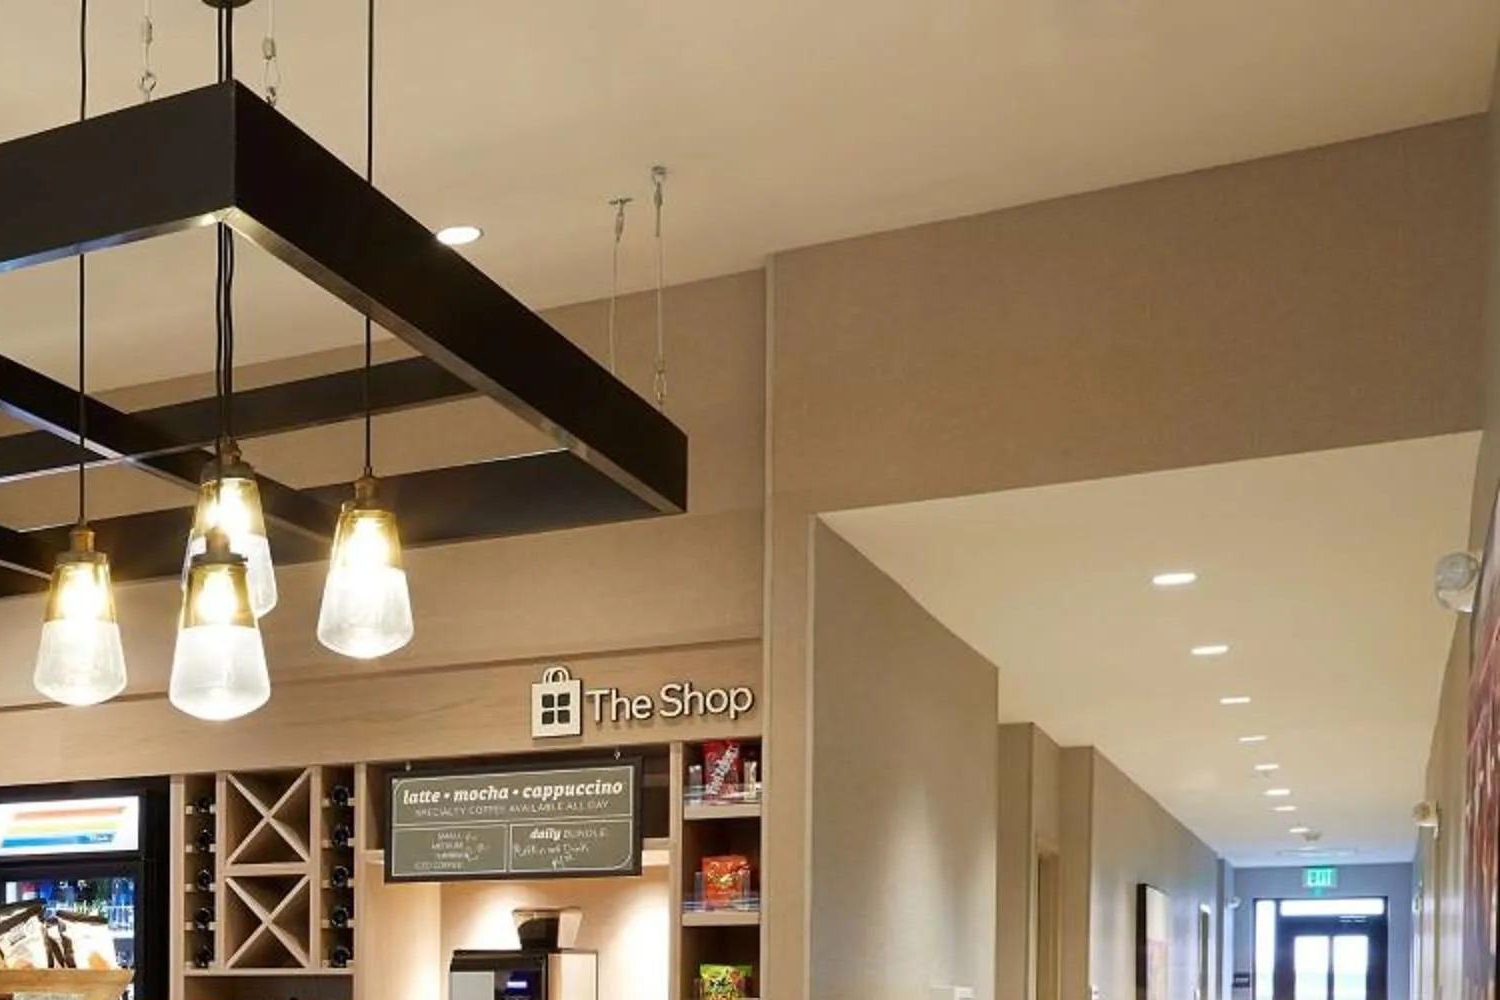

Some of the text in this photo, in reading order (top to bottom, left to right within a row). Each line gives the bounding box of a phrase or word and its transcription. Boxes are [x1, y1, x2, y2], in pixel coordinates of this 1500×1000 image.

[585, 682, 754, 723] The Shop
[403, 780, 624, 805] latte mocha cappuccino
[529, 827, 561, 841] daily
[1307, 868, 1333, 886] EXIT
